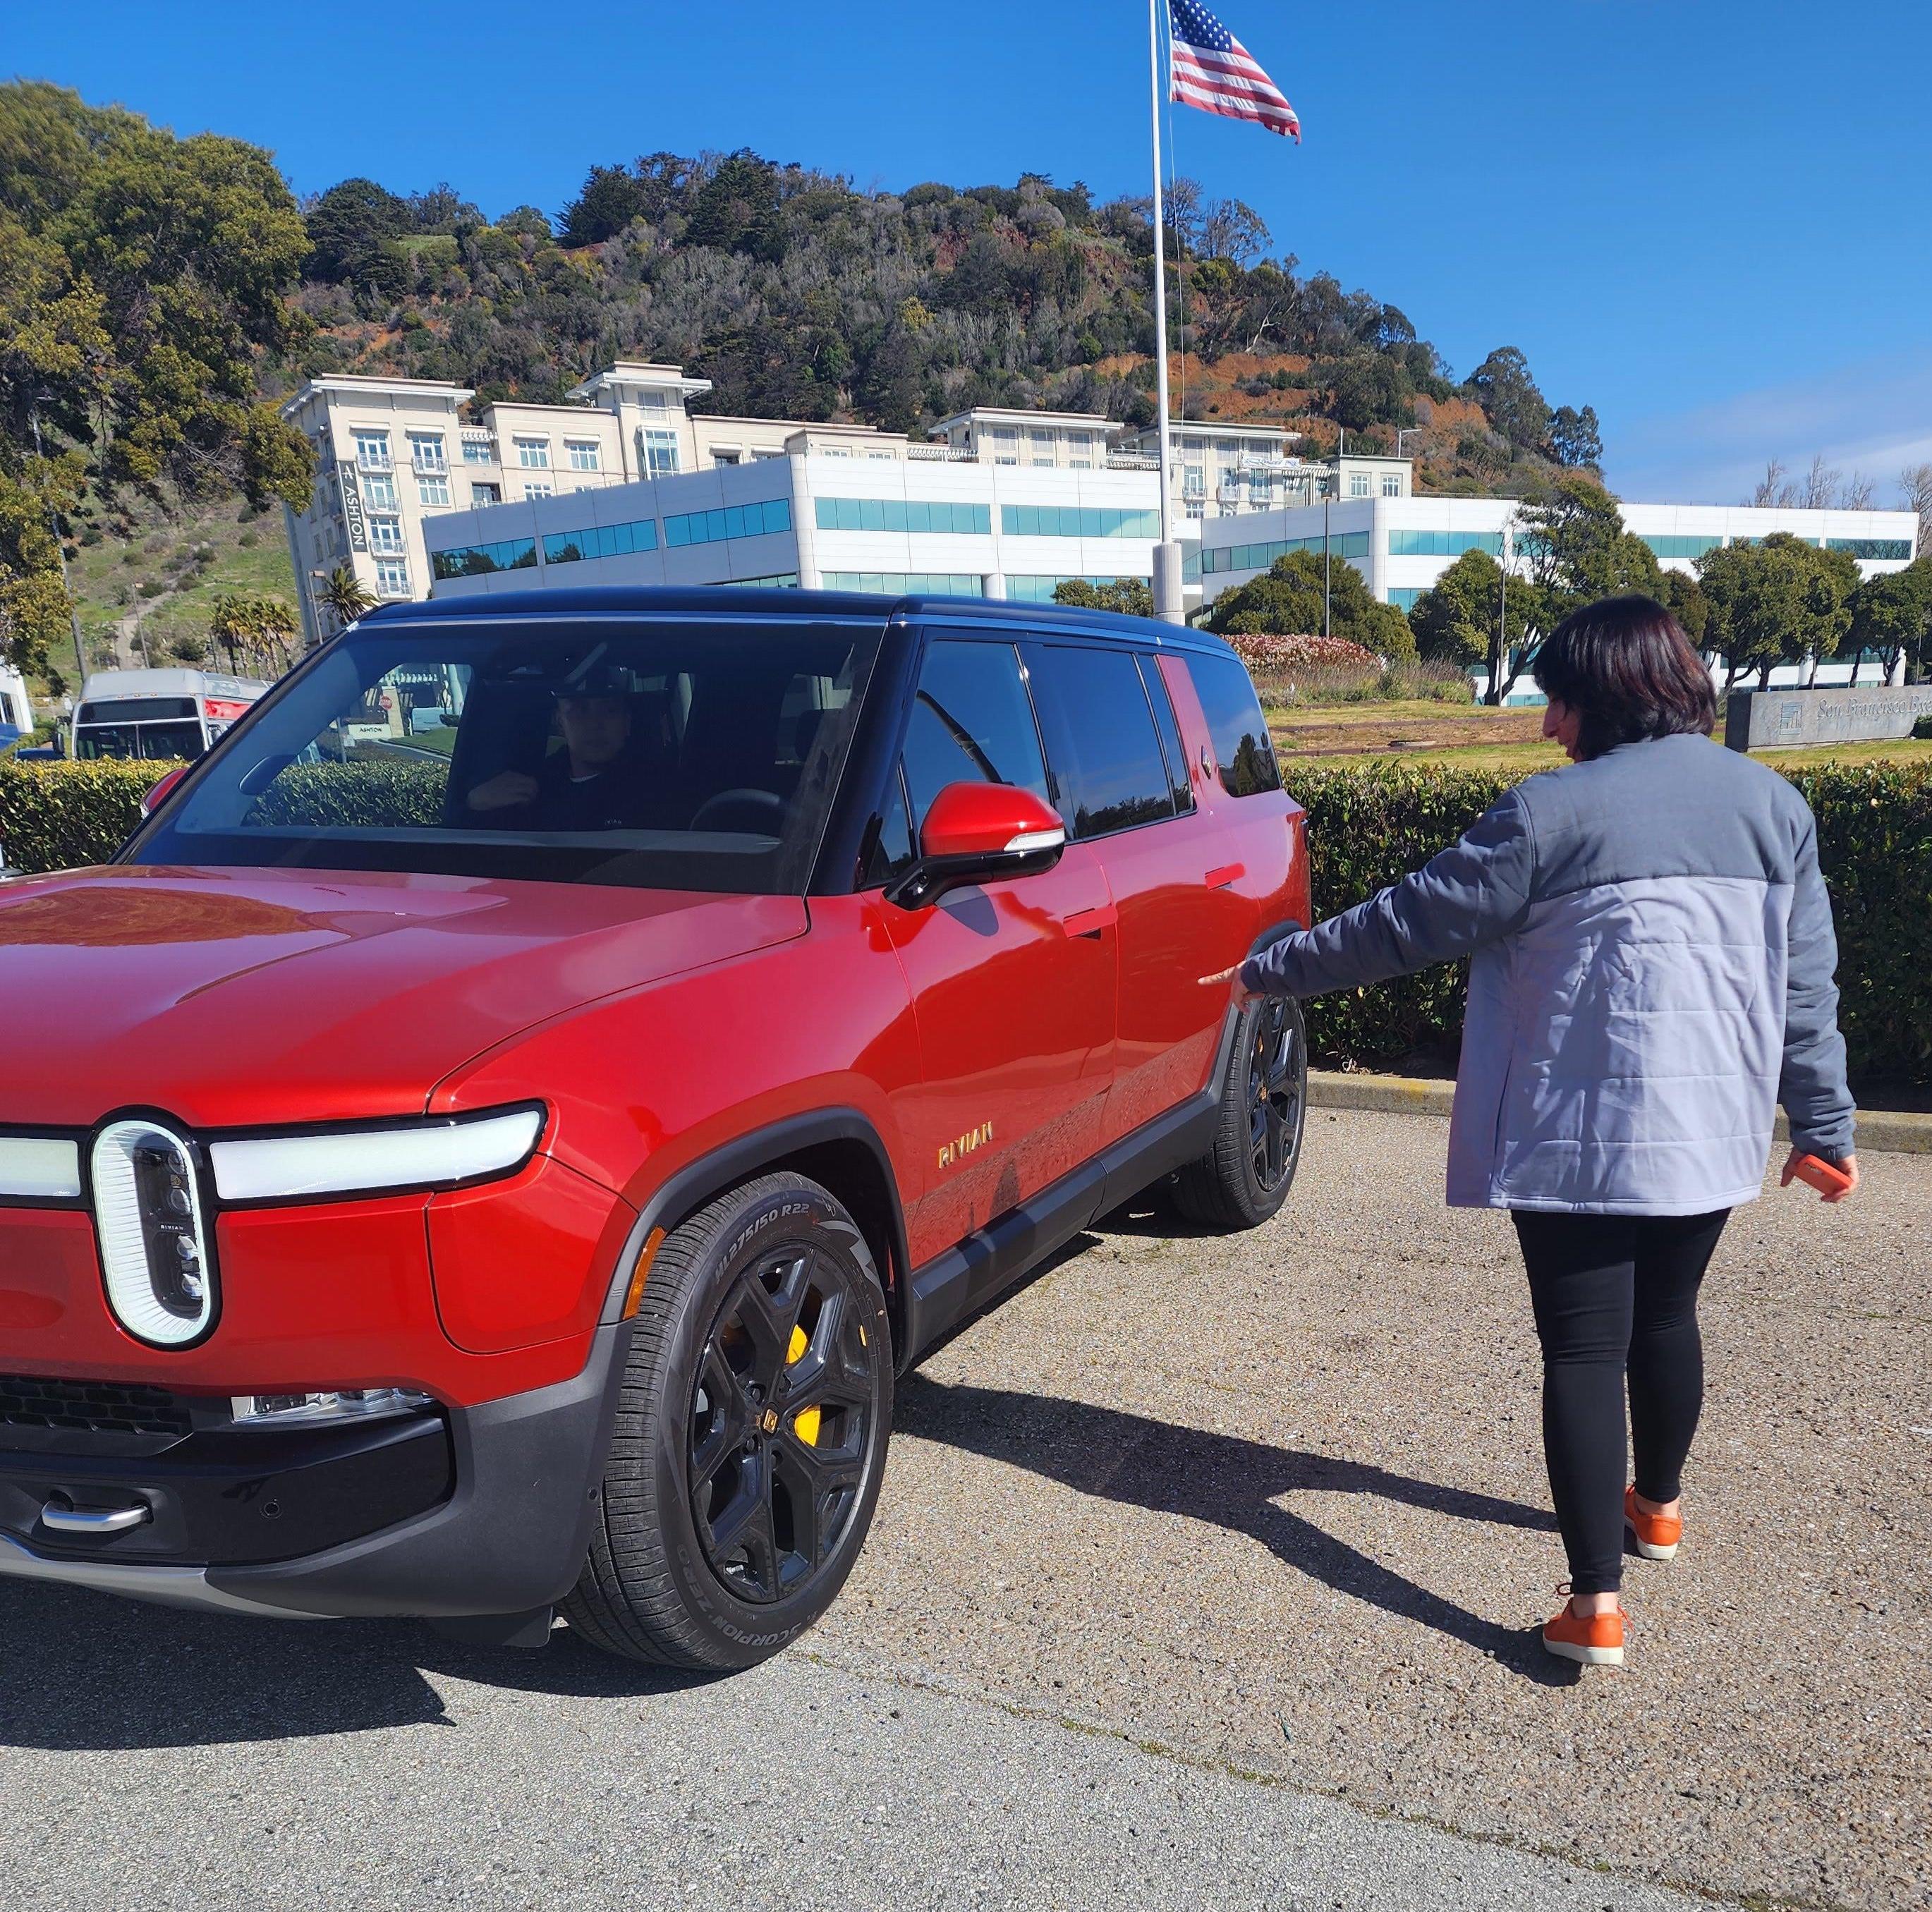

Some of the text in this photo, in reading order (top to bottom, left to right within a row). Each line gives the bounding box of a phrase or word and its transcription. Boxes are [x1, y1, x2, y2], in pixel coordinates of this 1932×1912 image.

[345, 486, 365, 544] ASHTON
[1817, 698, 1841, 720] San
[1846, 696, 1905, 717] Francisco
[938, 1121, 993, 1169] RIVIAN
[781, 1203, 810, 1217] R22
[676, 1544, 802, 1647] SCORPION ZERO
